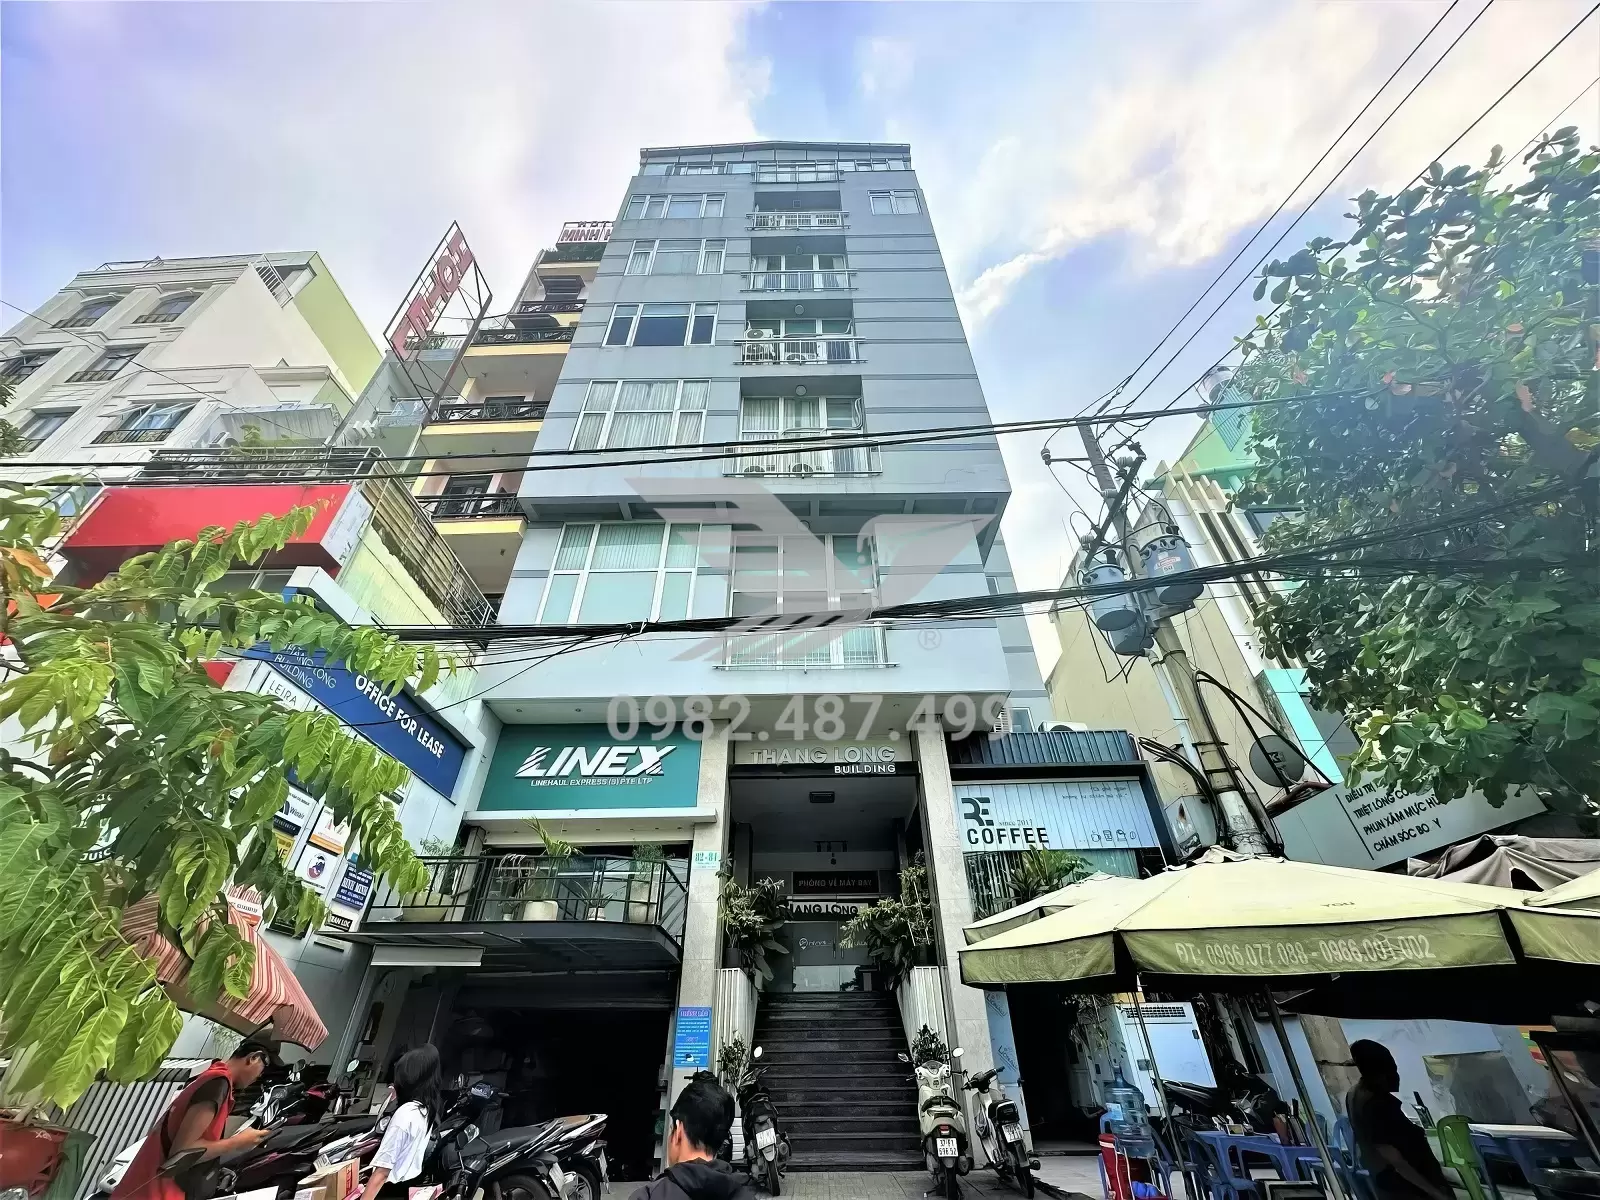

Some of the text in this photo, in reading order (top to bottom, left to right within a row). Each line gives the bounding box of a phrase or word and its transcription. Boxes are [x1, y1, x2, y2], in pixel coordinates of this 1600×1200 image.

[560, 229, 601, 241] MINH
[274, 654, 314, 689] BUILDING
[312, 668, 337, 689] LONG
[269, 679, 297, 706] LEIRA
[355, 674, 445, 759] OFFICE FOR LEASE
[514, 745, 677, 778] LINEX
[833, 746, 896, 764] LONG
[834, 764, 896, 774] BUILDING
[530, 779, 569, 787] LINEHAUL
[569, 778, 608, 786] EXPRESS
[999, 819, 1016, 827] since
[1363, 817, 1386, 836] PHUN
[966, 827, 1050, 845] COFFEE
[826, 903, 859, 915] LONG
